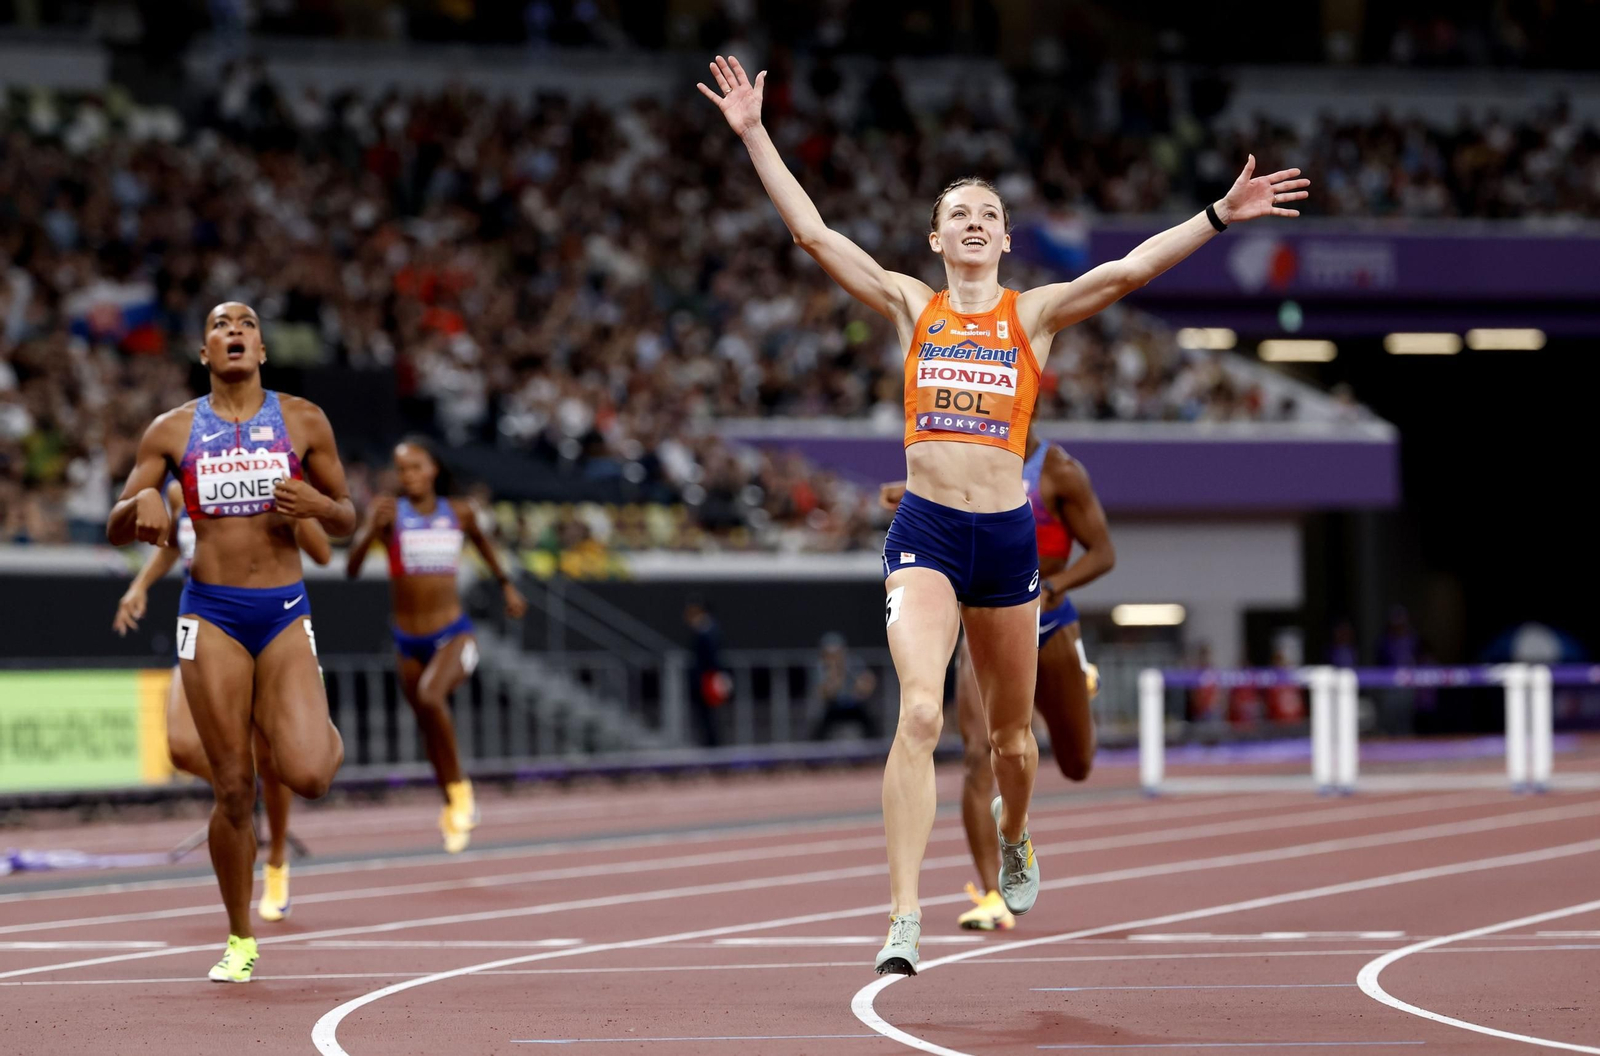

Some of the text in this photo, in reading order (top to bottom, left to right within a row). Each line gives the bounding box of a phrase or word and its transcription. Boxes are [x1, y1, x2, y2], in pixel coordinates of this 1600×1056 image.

[950, 329, 990, 337] Staatsloterij
[919, 367, 1014, 389] HONDA
[935, 388, 990, 415] BOL
[200, 459, 285, 475] HONDA
[180, 625, 190, 651] 7
